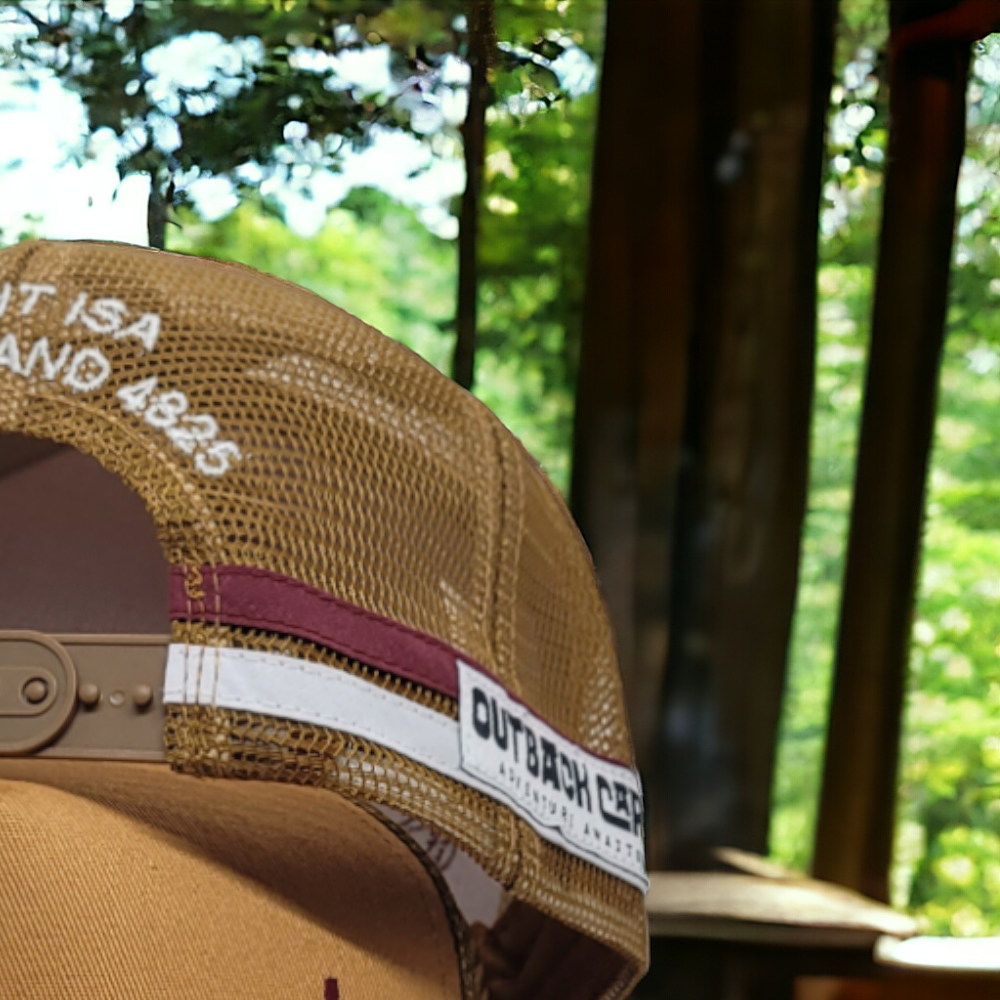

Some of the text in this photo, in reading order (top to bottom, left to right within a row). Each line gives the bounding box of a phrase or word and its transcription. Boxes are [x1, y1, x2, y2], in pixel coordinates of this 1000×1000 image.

[65, 292, 162, 352] ISA
[117, 376, 241, 477] 4825
[472, 687, 593, 813] OUTBACK
